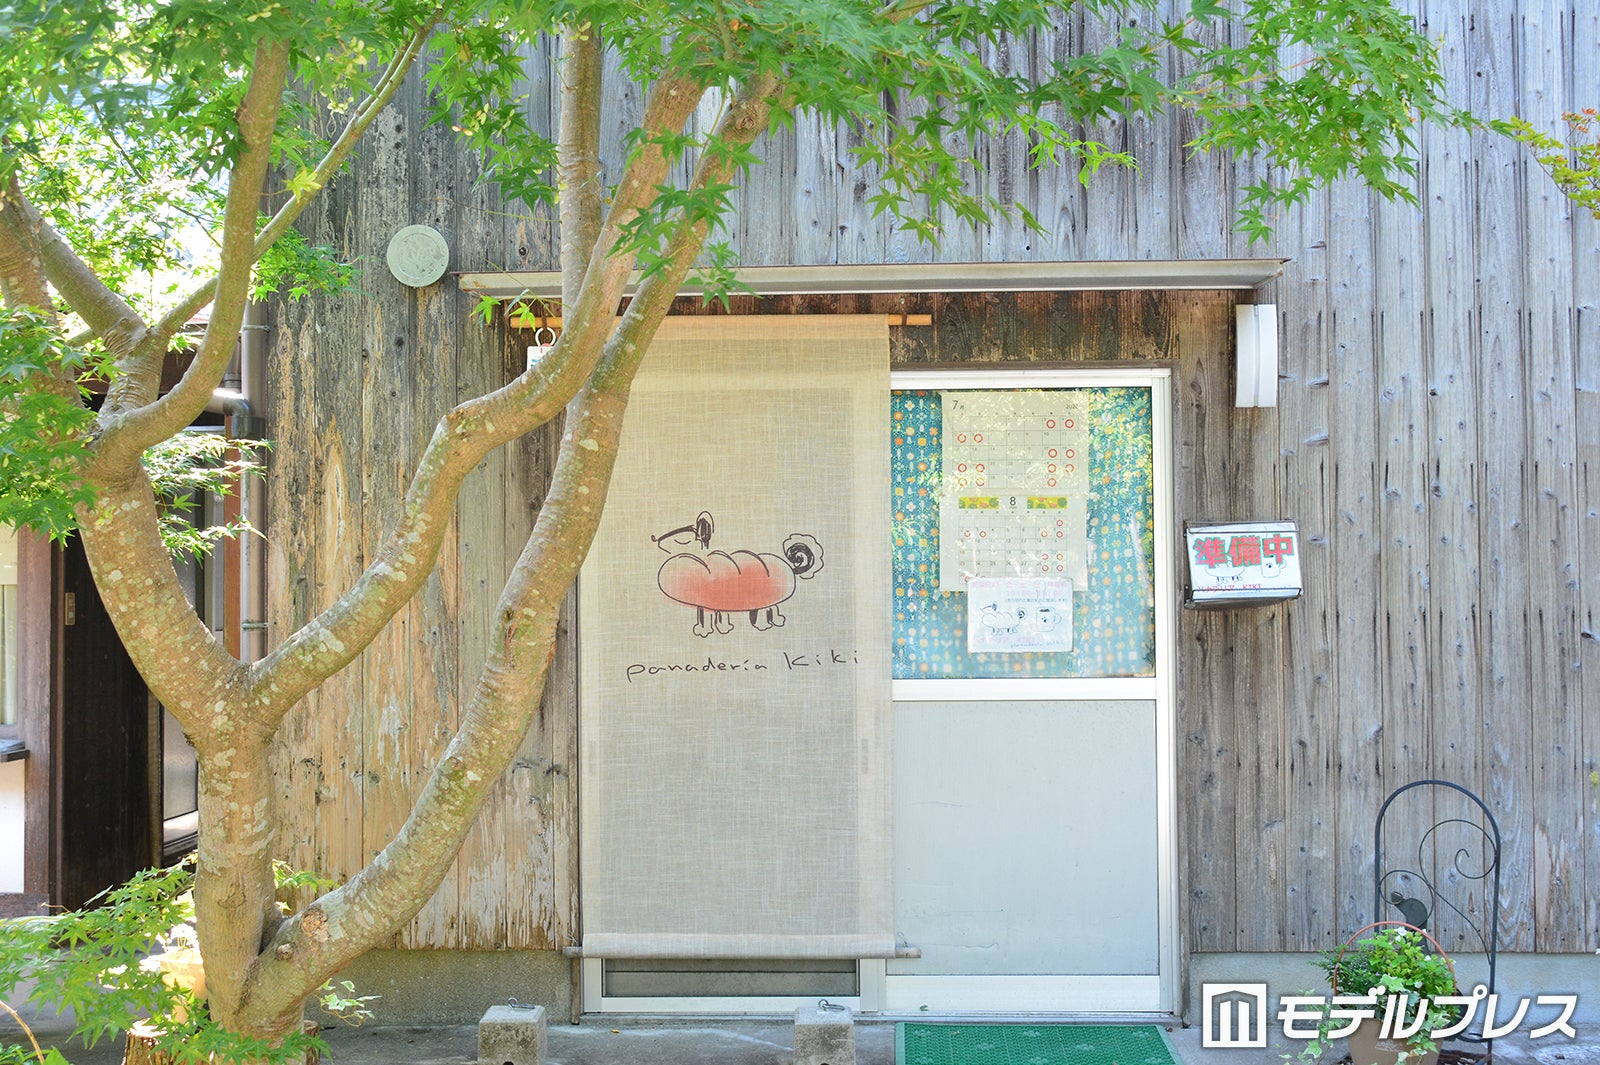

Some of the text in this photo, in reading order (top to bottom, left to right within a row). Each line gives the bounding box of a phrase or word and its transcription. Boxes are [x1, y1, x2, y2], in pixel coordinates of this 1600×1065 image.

[1009, 496, 1016, 506] 8
[1193, 533, 1295, 569] 準備中
